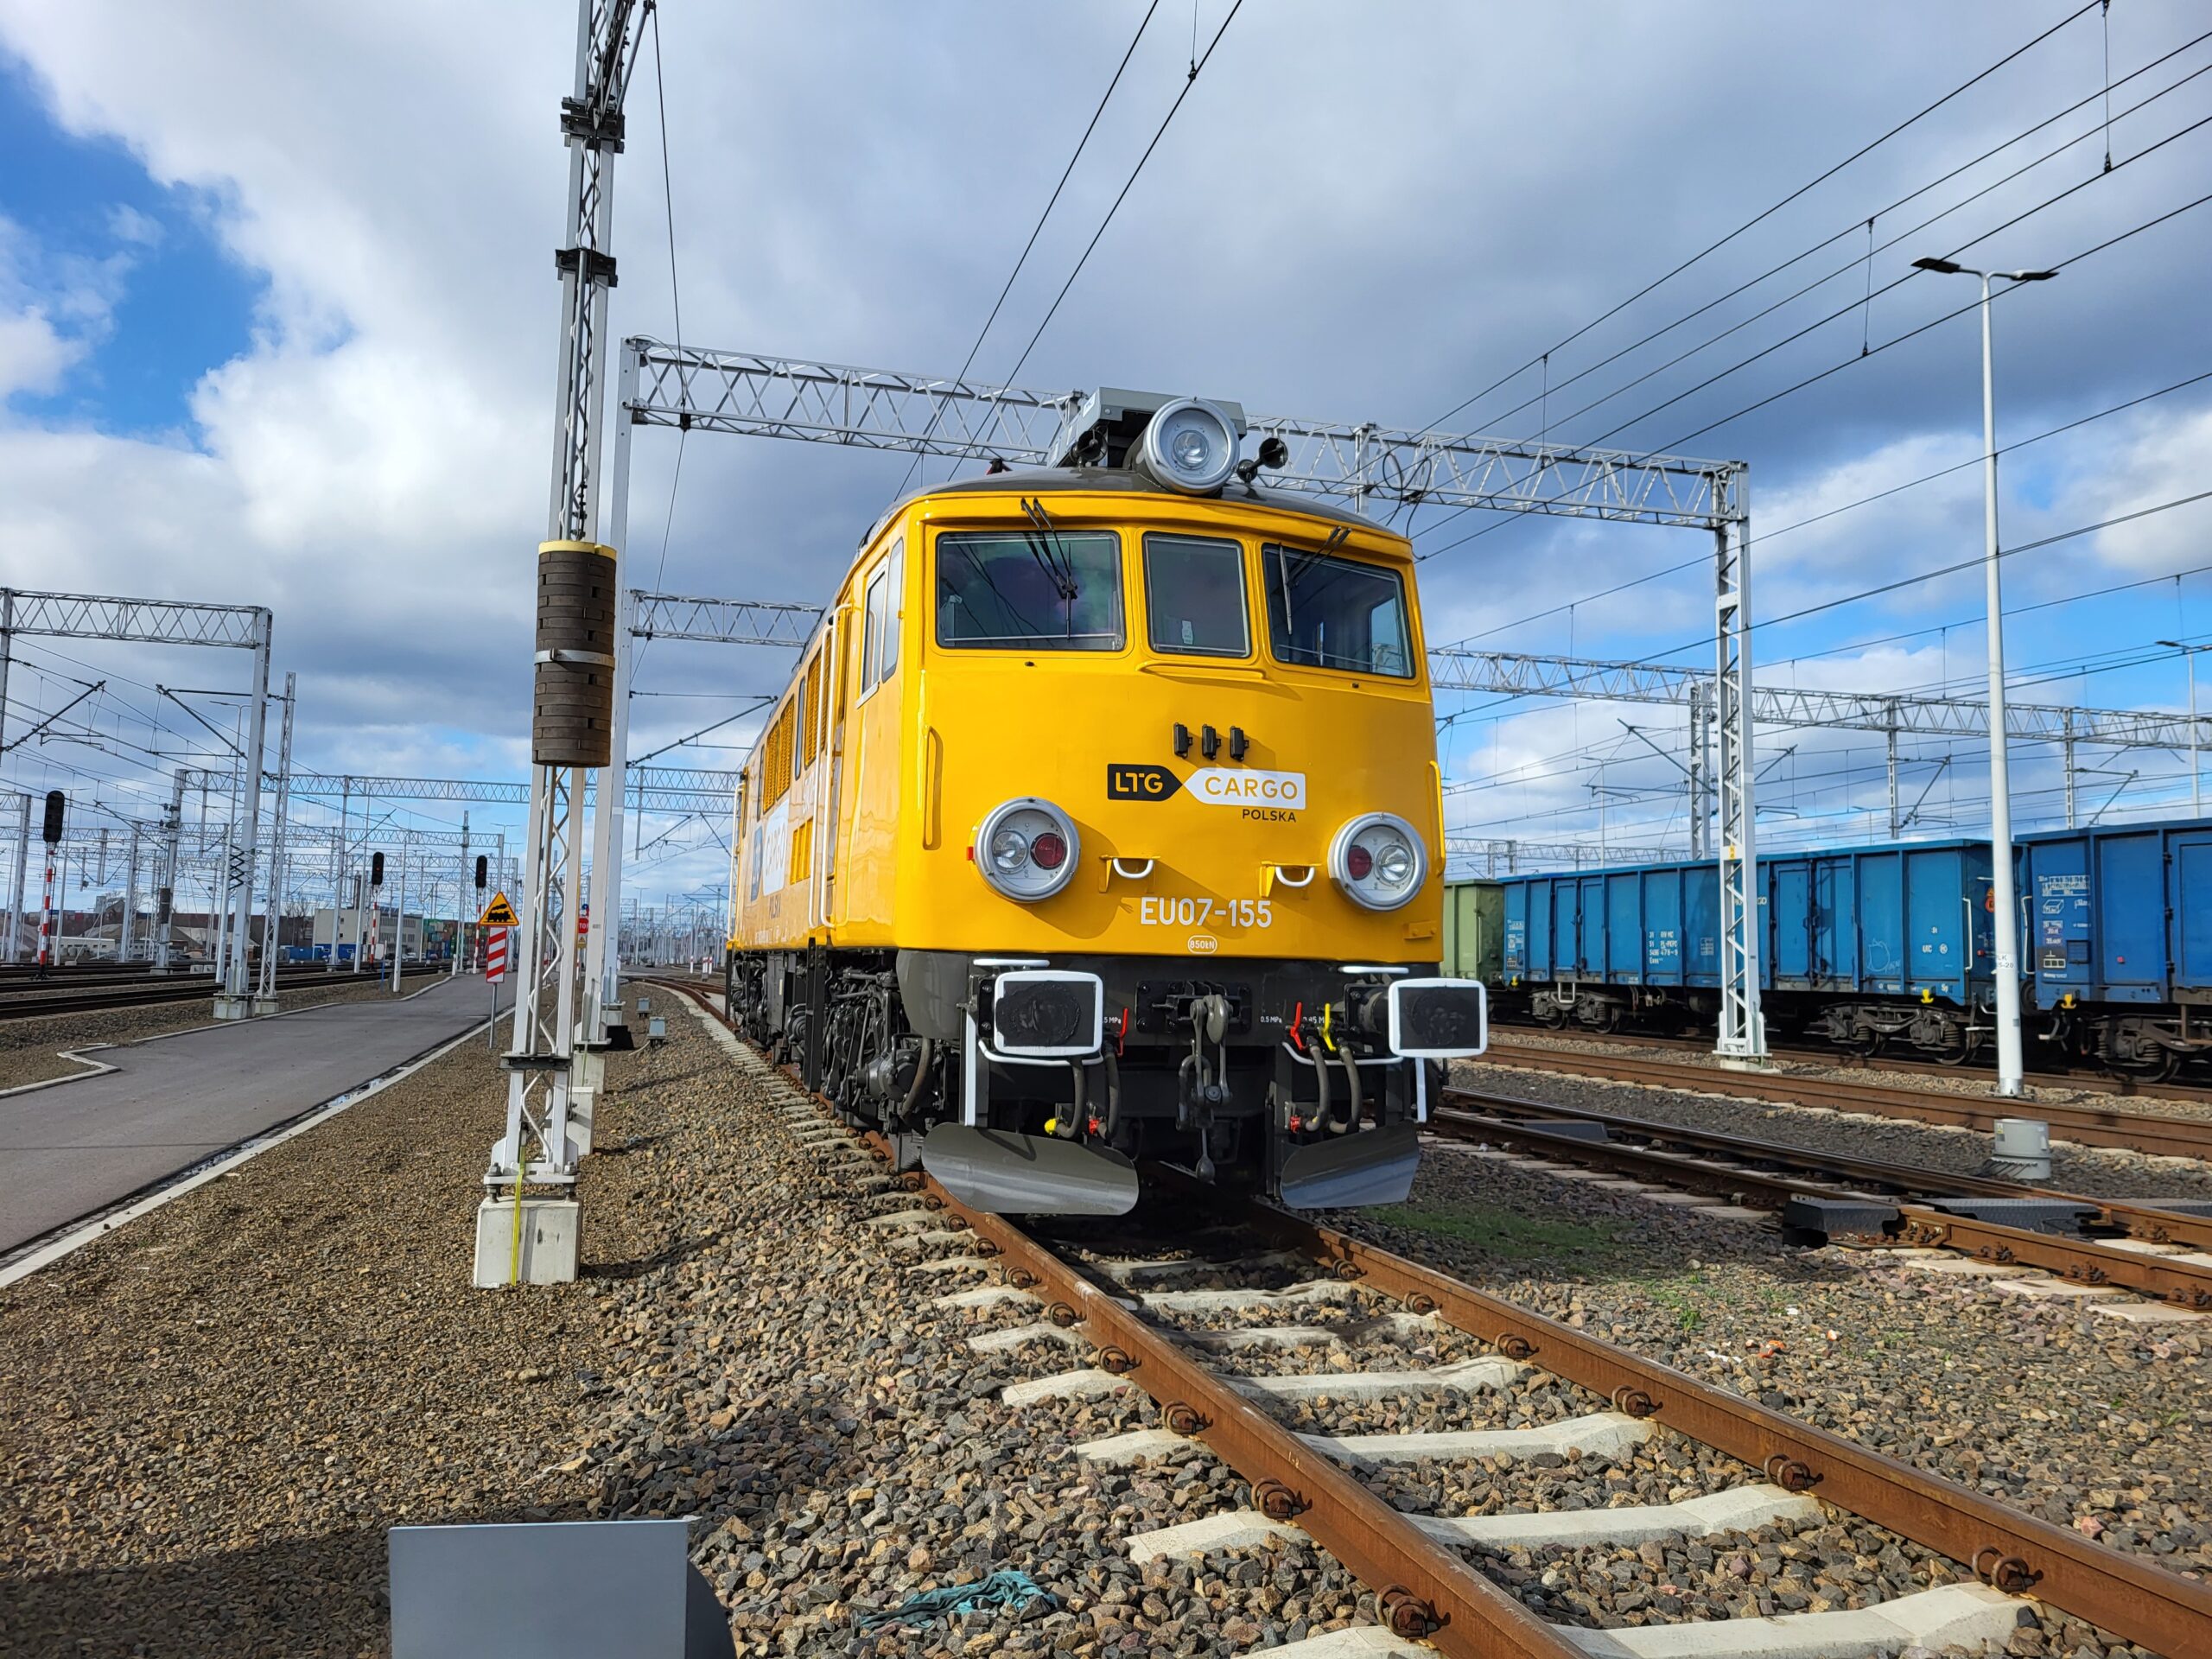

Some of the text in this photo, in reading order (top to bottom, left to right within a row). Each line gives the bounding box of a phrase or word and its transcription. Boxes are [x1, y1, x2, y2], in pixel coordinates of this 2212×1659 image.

[1115, 772, 1298, 800] LTG CARGO
[1242, 809, 1296, 823] POLSKA
[1141, 896, 1273, 928] EU07-155
